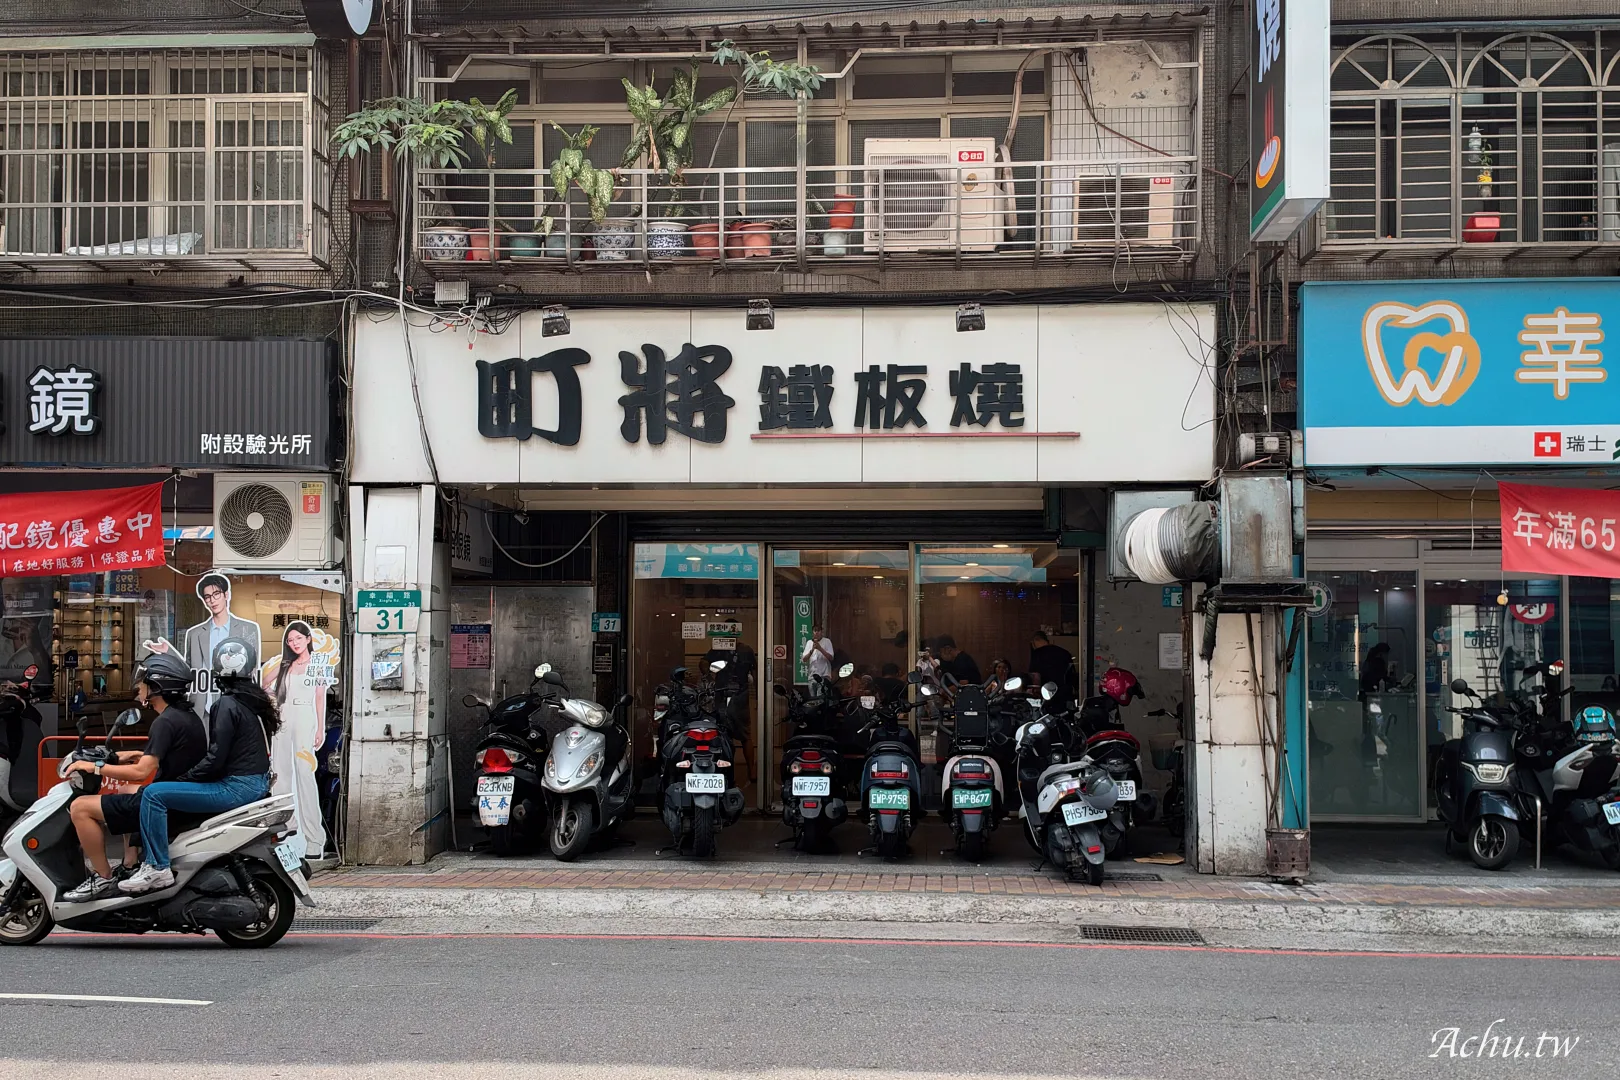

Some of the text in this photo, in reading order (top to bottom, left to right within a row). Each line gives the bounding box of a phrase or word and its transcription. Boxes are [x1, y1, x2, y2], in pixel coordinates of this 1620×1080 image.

[1517, 308, 1606, 399] 幸
[29, 366, 95, 434] 鏡
[200, 433, 312, 455] 附設驗光所
[1566, 435, 1607, 453] 瑞士
[1513, 507, 1616, 551] 年滿65
[13, 547, 156, 573] 在地好服務 保證品質
[376, 609, 404, 630] 31
[604, 620, 617, 630] 31
[310, 652, 330, 665] 活力
[306, 665, 335, 678] 超氣質
[303, 678, 328, 687] QINA
[478, 782, 513, 793] 623-KNB
[687, 778, 723, 788] NKF-2028
[794, 781, 828, 791] NWF-7957
[871, 793, 908, 805] EWP-9758
[954, 793, 990, 805] EWP-8677
